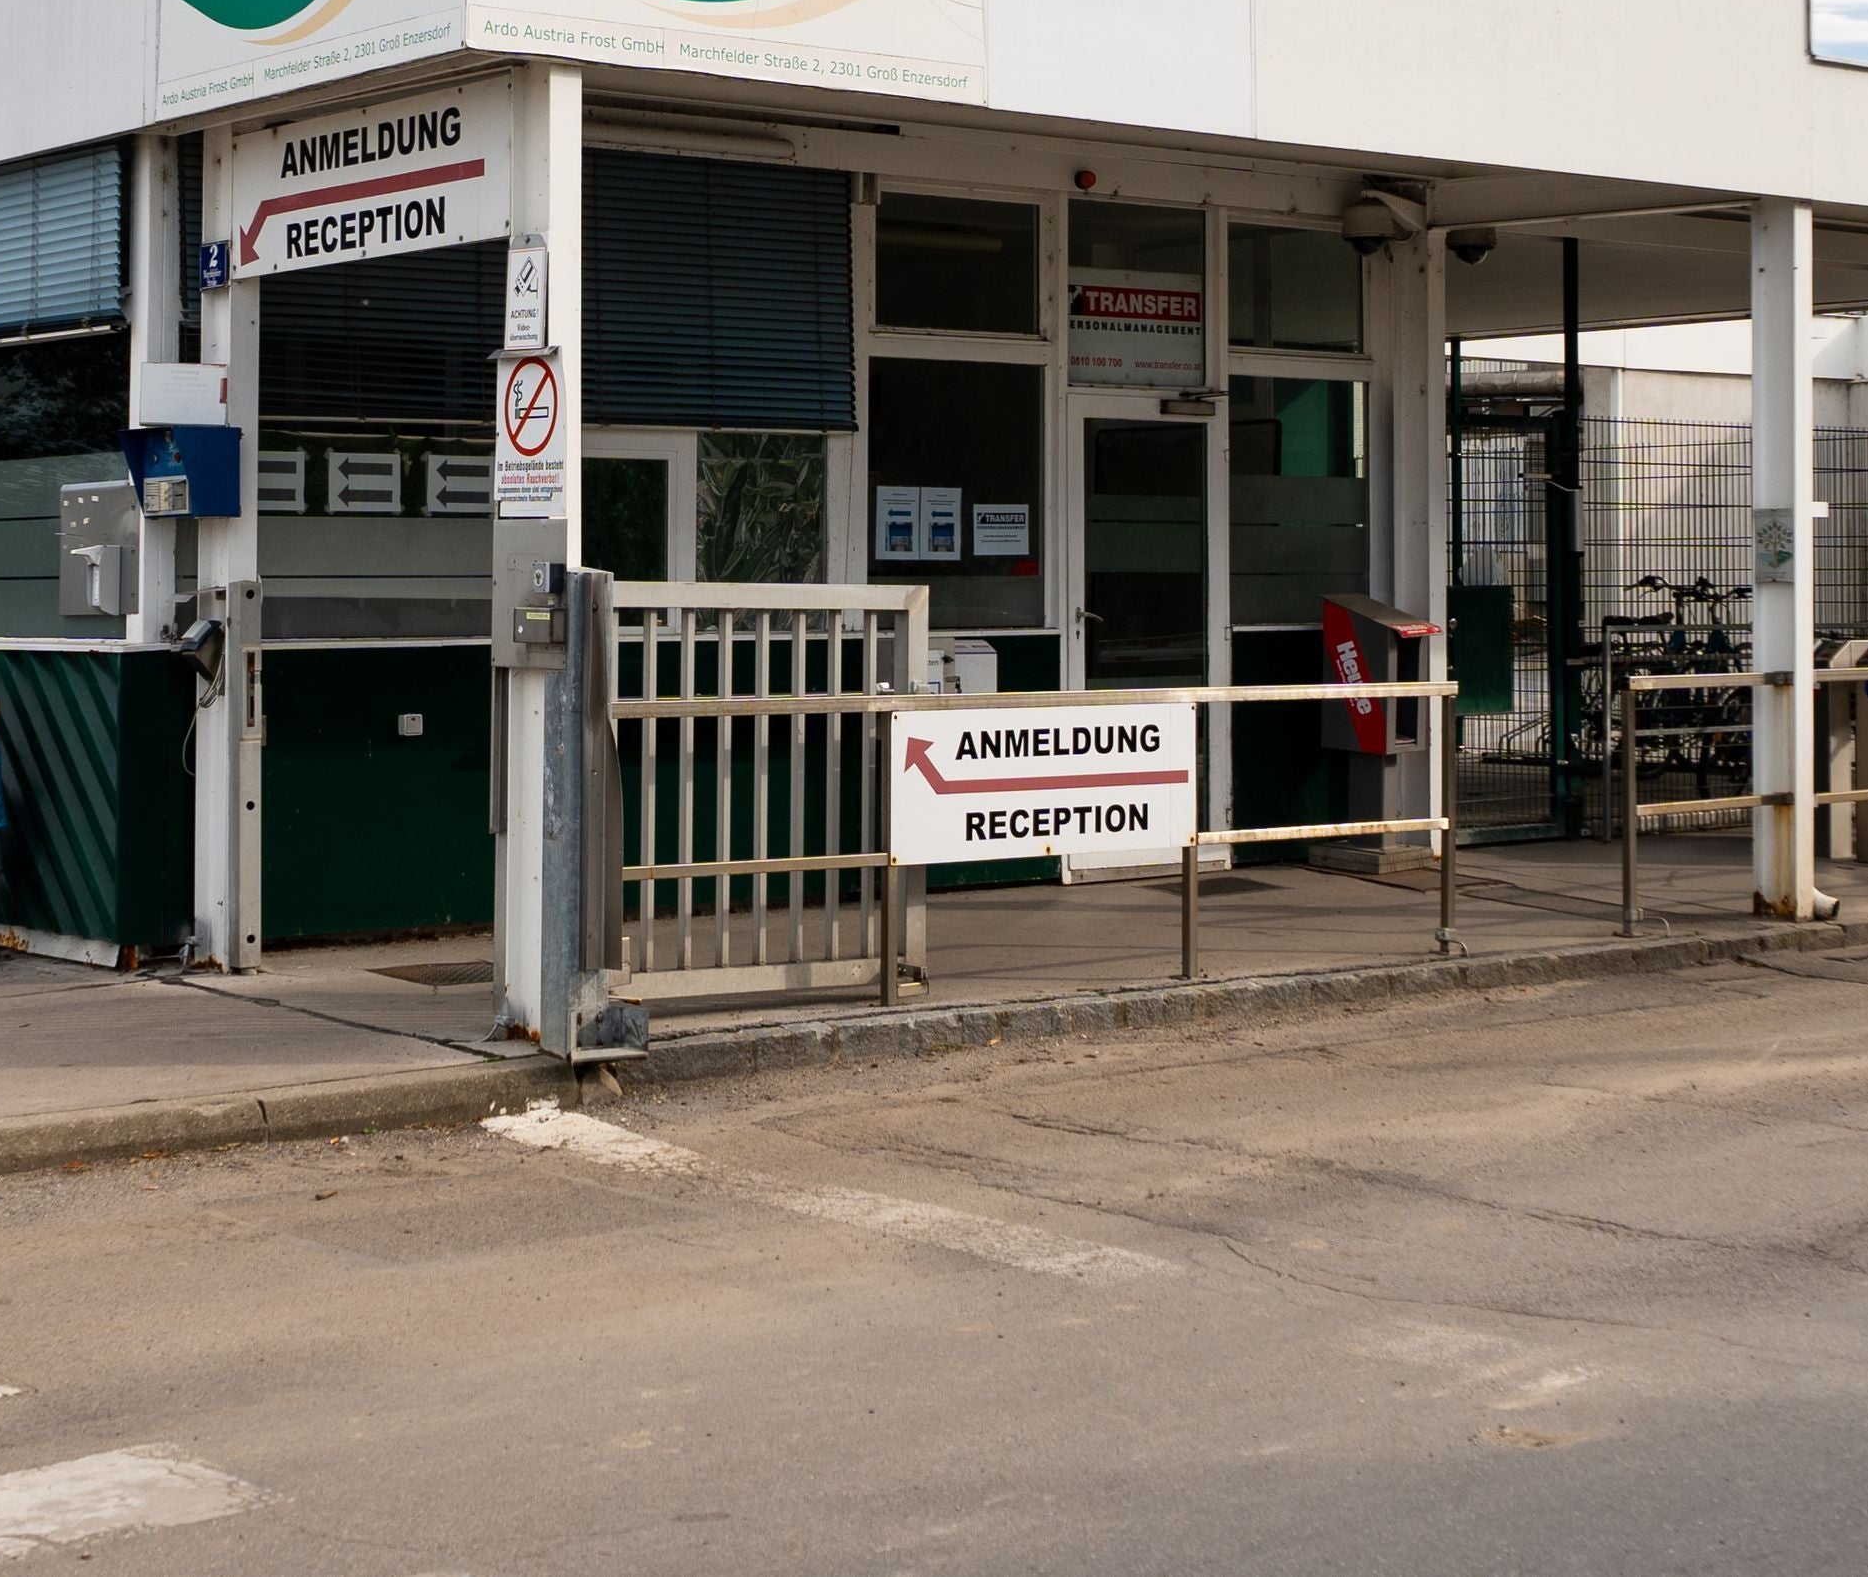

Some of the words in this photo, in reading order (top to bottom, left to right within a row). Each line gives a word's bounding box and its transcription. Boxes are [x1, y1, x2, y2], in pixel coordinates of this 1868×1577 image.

[264, 58, 311, 81] Marchfelder
[314, 51, 342, 69] Straße
[343, 48, 352, 63] 2,
[354, 41, 376, 58] 2301
[379, 34, 401, 52] Groß
[403, 22, 451, 47] Enzersdorf
[484, 20, 518, 37] Ardo
[524, 25, 574, 43] Austria
[581, 32, 616, 49] Frost
[622, 37, 664, 54] GmbH
[679, 43, 759, 65] Marchfelder
[764, 53, 807, 71] Straße
[812, 59, 825, 75] 2,
[830, 61, 861, 77] 2301
[867, 65, 898, 81] Groß
[902, 69, 968, 89] Enzersdorf
[162, 93, 179, 106] Ardo
[181, 85, 207, 102] Austria
[209, 81, 228, 97] Frost
[230, 72, 254, 90] GmbH
[280, 106, 462, 179] ANMELDUNG
[286, 196, 446, 260] RECEPTION
[209, 245, 218, 267] 2
[1085, 291, 1197, 316] TRANSFER
[1069, 320, 1201, 335] ERSONALMANAGEMENT
[1071, 356, 1090, 366] 0810
[1092, 357, 1106, 367] 100
[1108, 358, 1122, 368] 700
[985, 514, 1025, 523] TRANSFER
